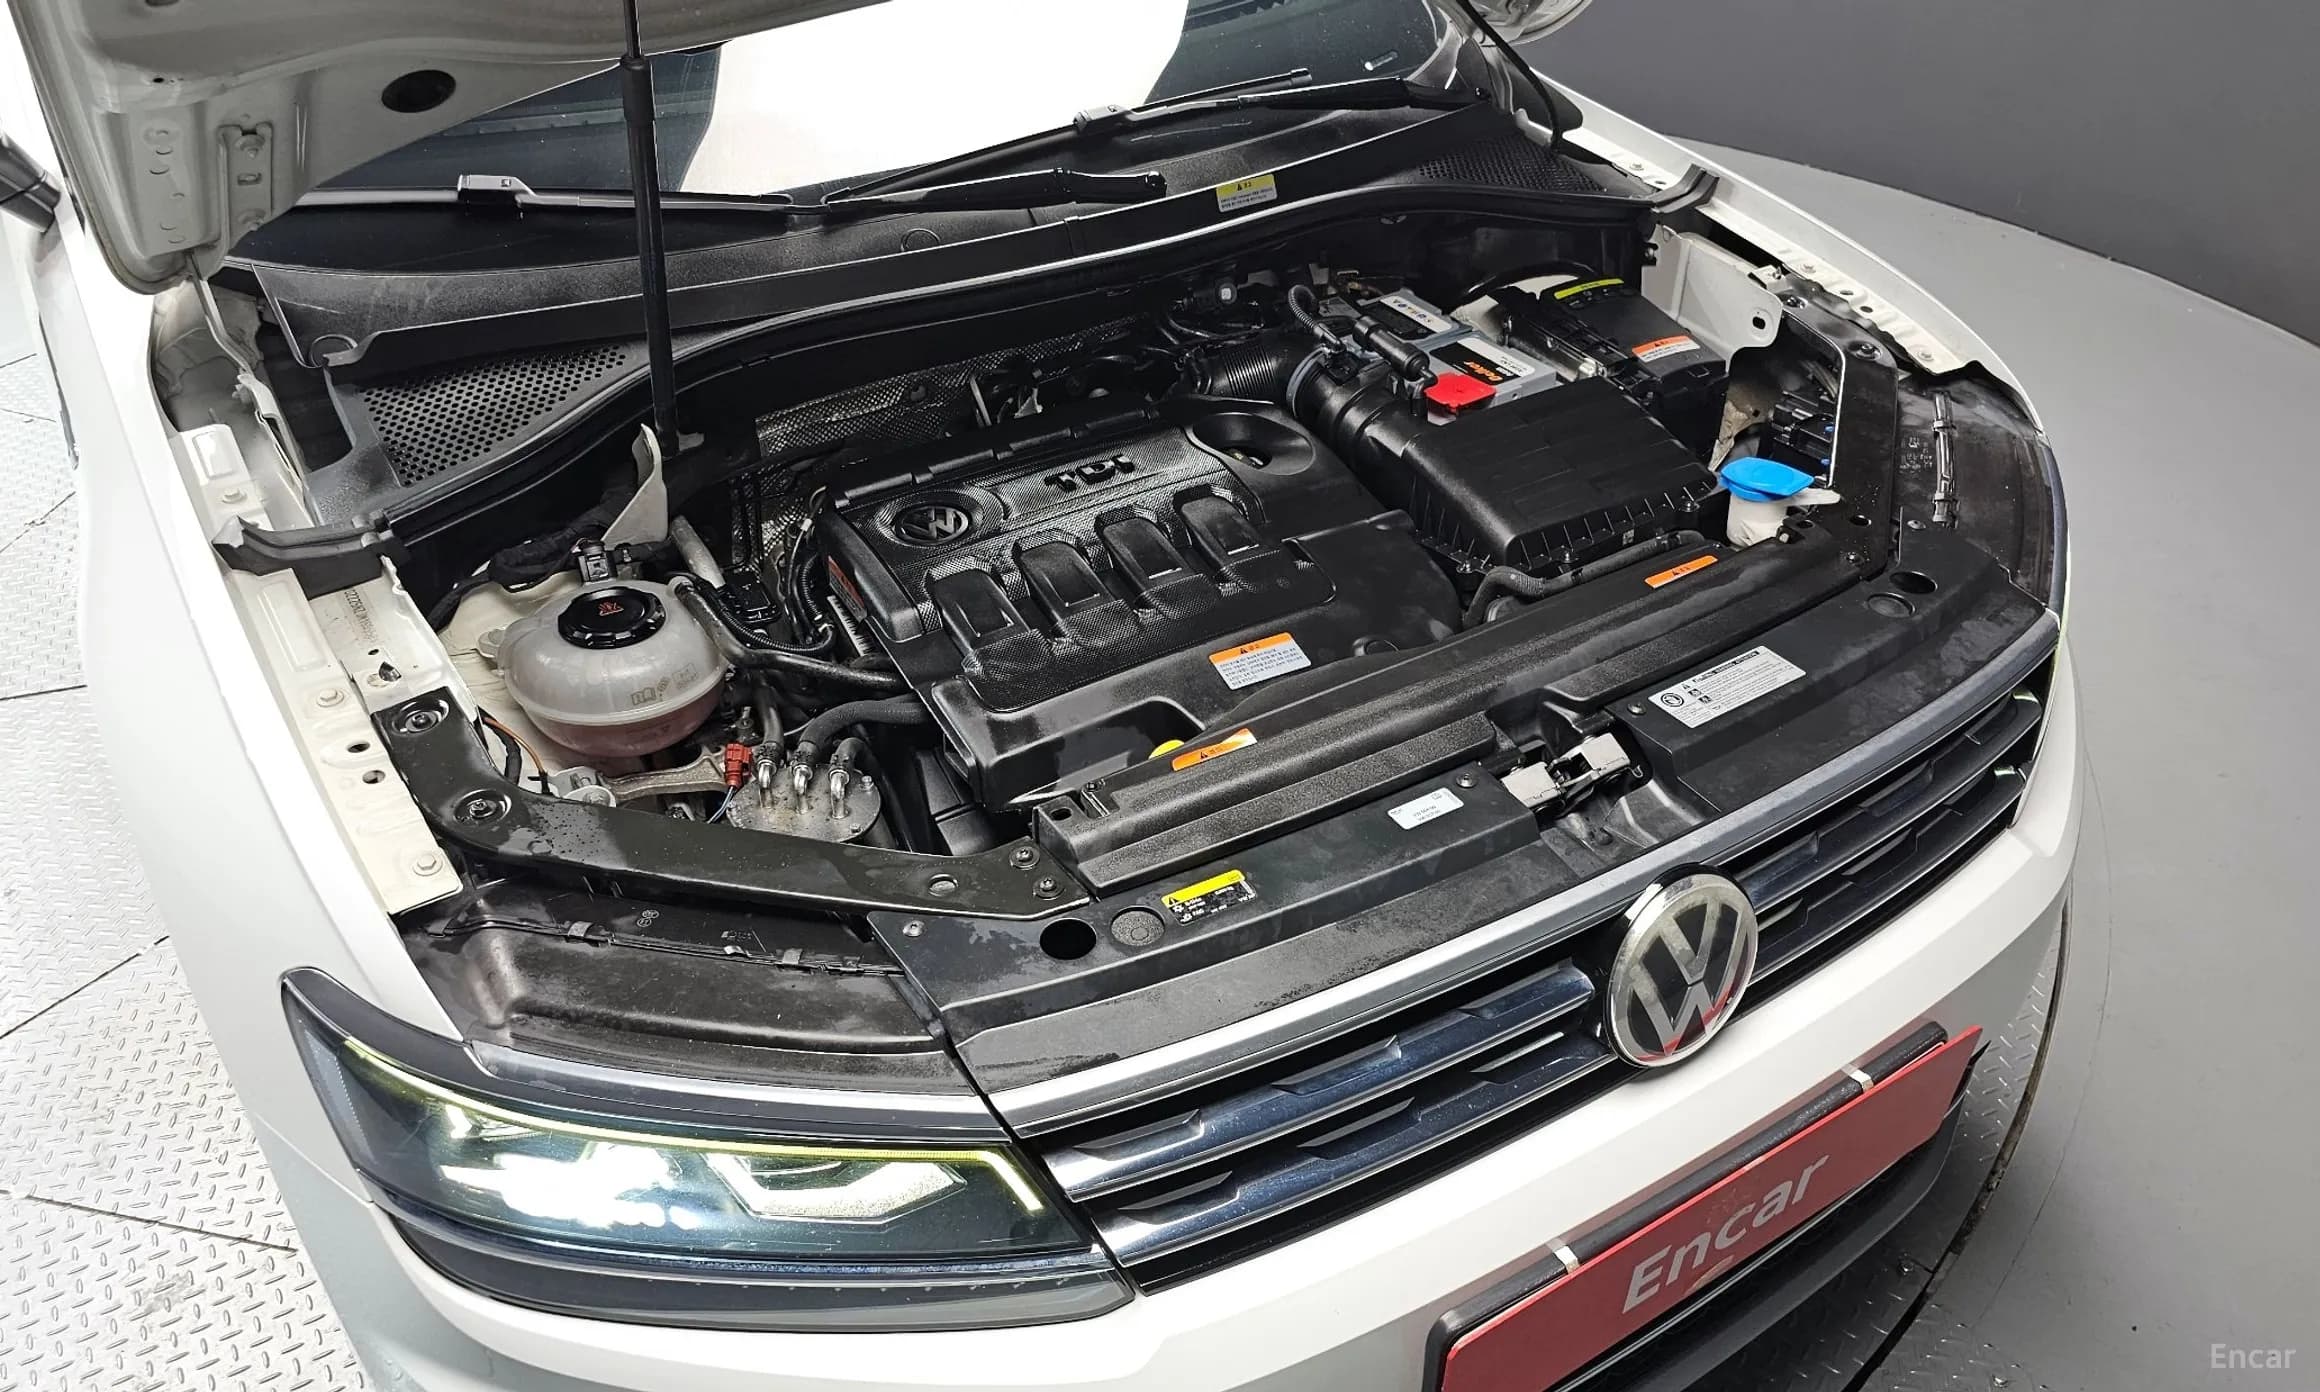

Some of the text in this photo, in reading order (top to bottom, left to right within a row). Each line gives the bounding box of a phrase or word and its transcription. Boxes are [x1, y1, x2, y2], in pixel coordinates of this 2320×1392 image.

[1044, 454, 1135, 492] TDI
[1611, 876, 1757, 1064] VW
[1622, 1154, 1830, 1315] Encar
